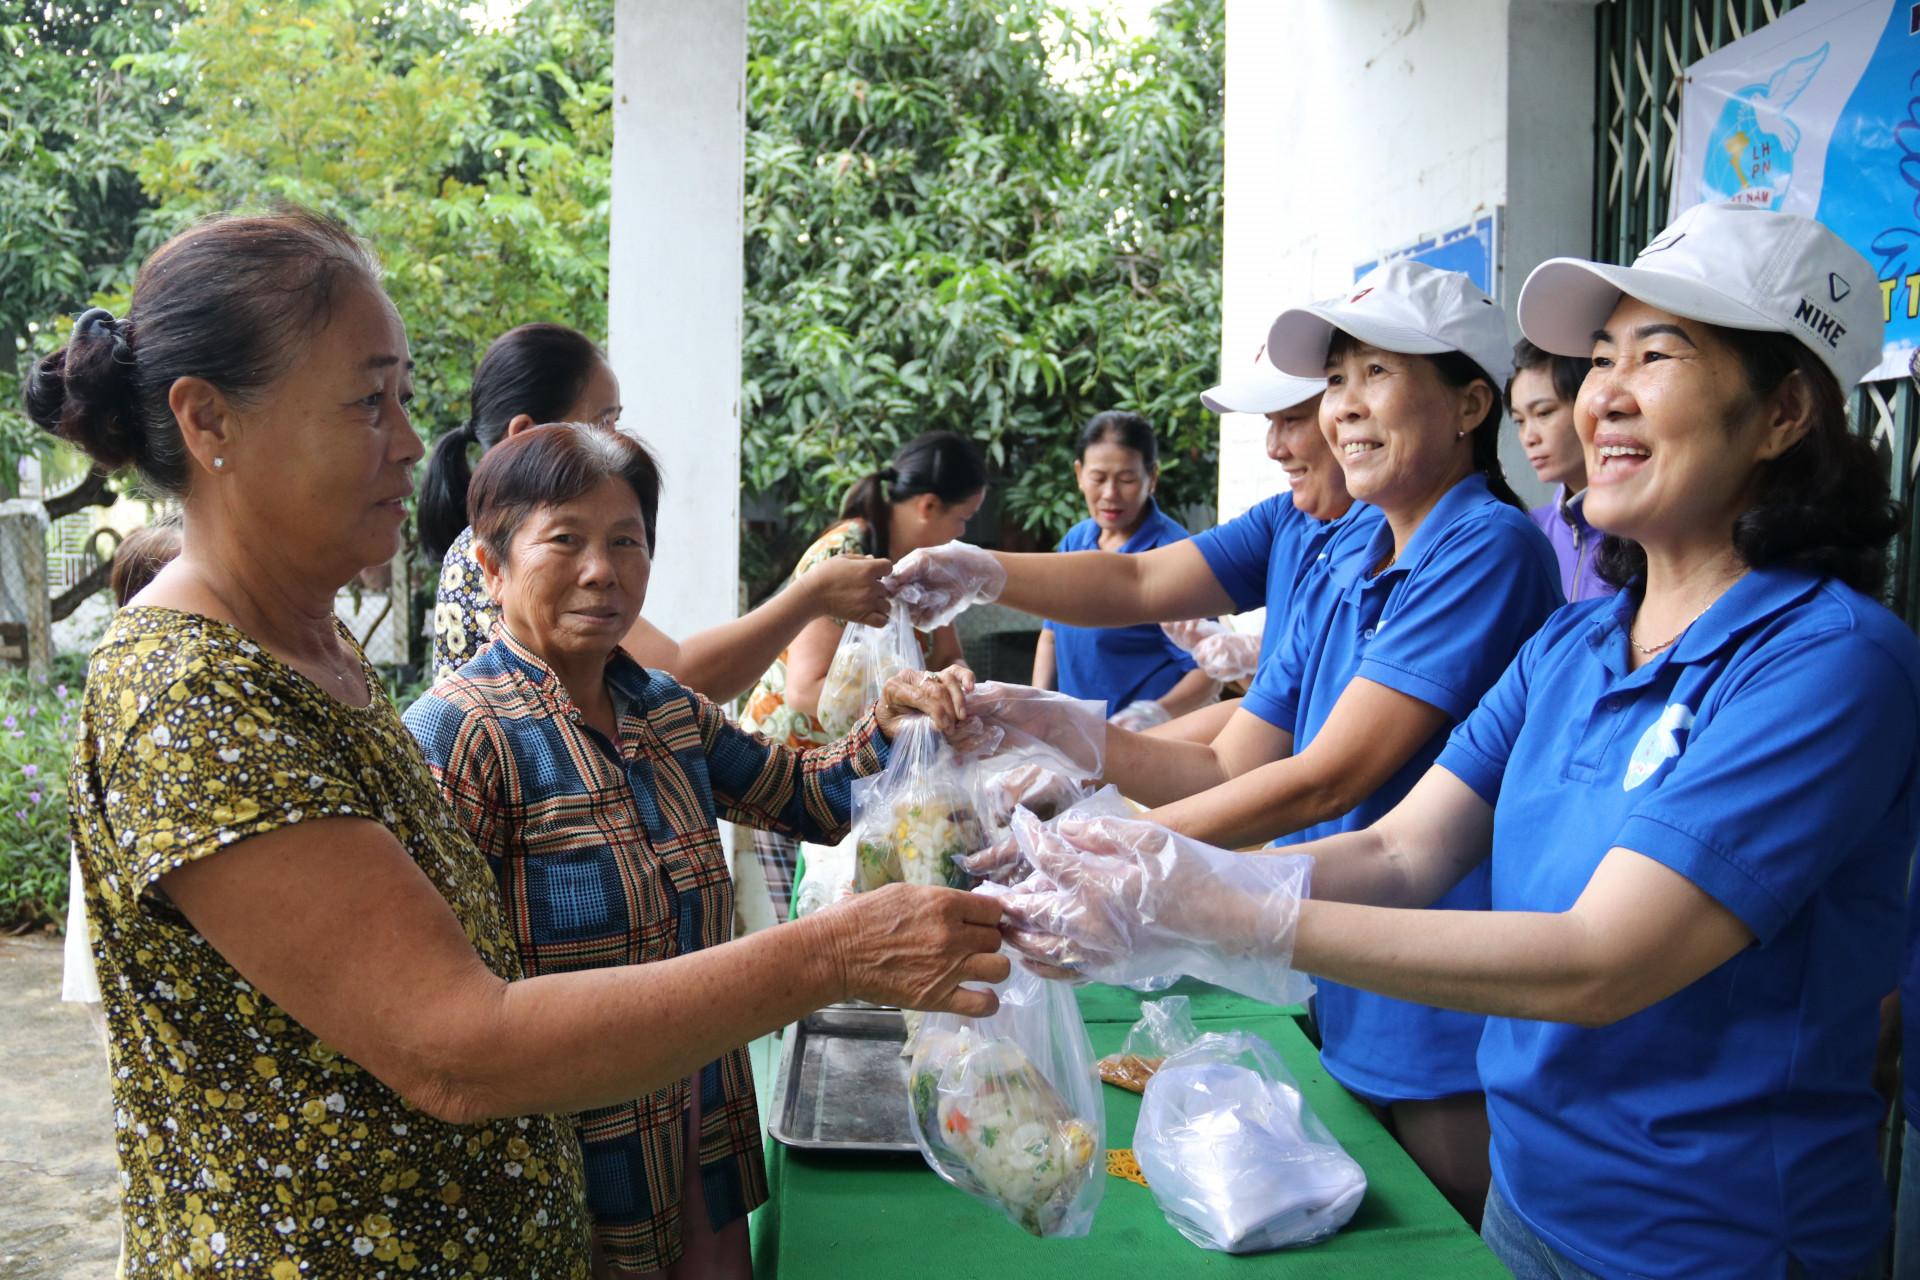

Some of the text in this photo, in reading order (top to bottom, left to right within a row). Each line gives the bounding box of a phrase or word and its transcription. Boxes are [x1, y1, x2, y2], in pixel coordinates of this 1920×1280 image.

[1753, 141, 1770, 161] LH
[1752, 159, 1771, 180] PN
[1794, 297, 1847, 349] NIKE
